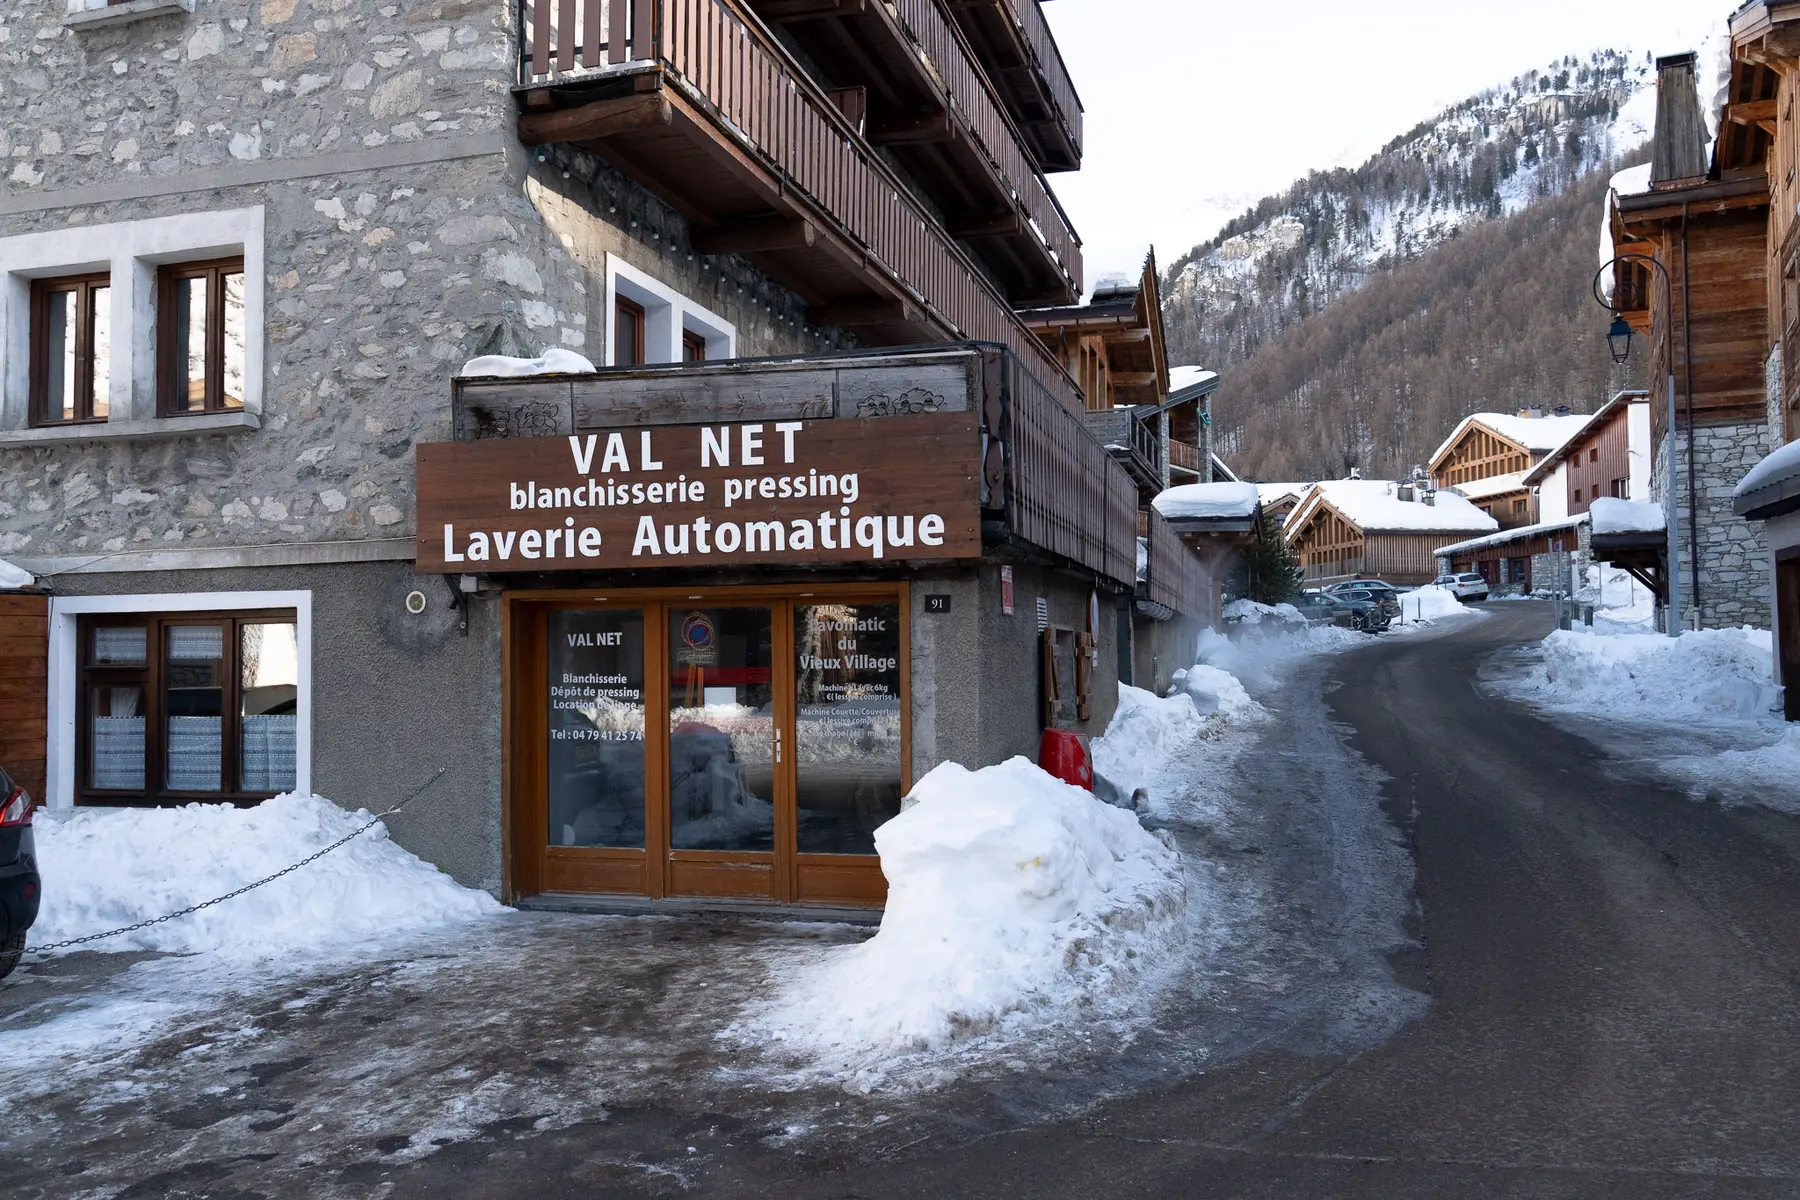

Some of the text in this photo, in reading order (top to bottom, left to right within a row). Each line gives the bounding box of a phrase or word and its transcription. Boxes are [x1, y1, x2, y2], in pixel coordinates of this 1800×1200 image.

[568, 421, 804, 475] VAL NET
[510, 468, 859, 510] blanchisserie pressing
[444, 506, 946, 563] Laverie Automatique
[931, 598, 944, 609] 91
[809, 616, 886, 631] Lavomatic
[567, 632, 623, 647] VAL NET
[837, 636, 857, 650] du
[799, 654, 896, 672] Vieux Village
[562, 673, 628, 684] Blanchisserie
[551, 686, 640, 699] Dépôt de pressing
[553, 699, 595, 709] Location
[572, 730, 585, 740] 04
[587, 730, 599, 740] 79
[601, 730, 613, 741] 41
[615, 731, 628, 741] 25
[630, 731, 642, 741] 74
